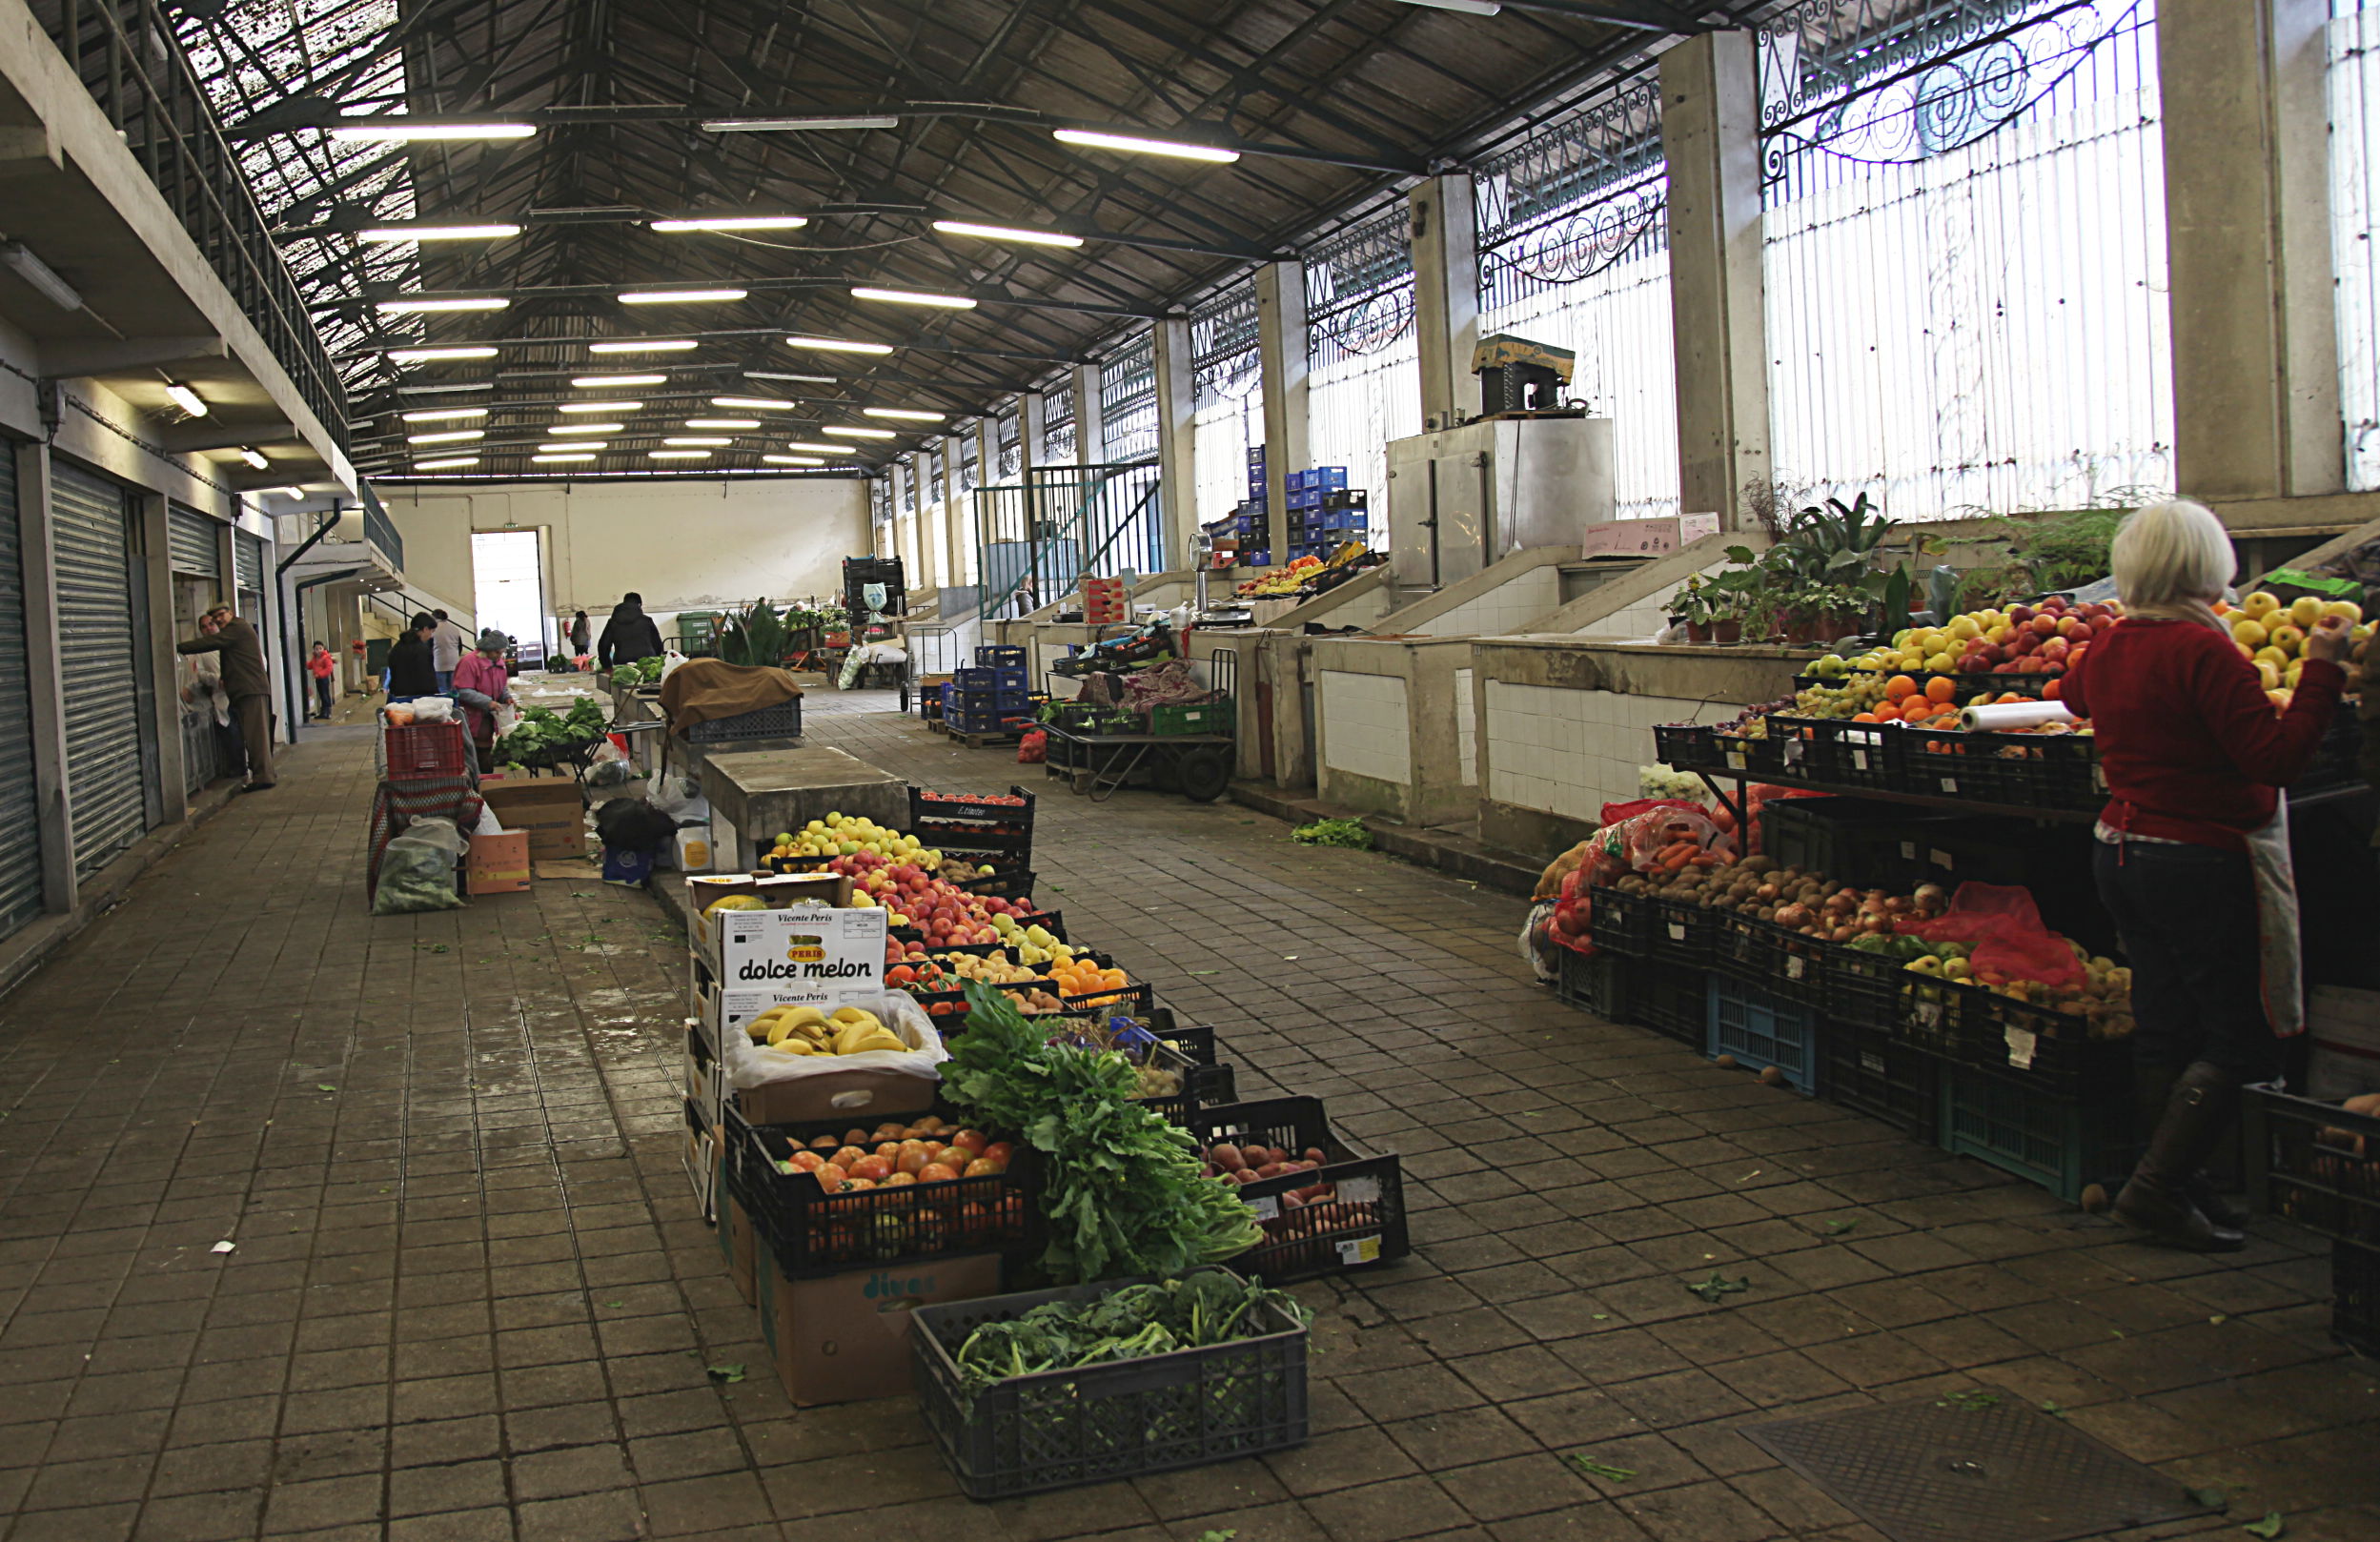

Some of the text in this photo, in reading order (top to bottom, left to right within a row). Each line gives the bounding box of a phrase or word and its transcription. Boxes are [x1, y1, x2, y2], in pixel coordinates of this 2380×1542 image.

[778, 913, 832, 923] Vicente Peris
[791, 950, 823, 959] PERIS
[739, 957, 872, 981] dolce melon
[773, 993, 828, 1003] Vicente Peris
